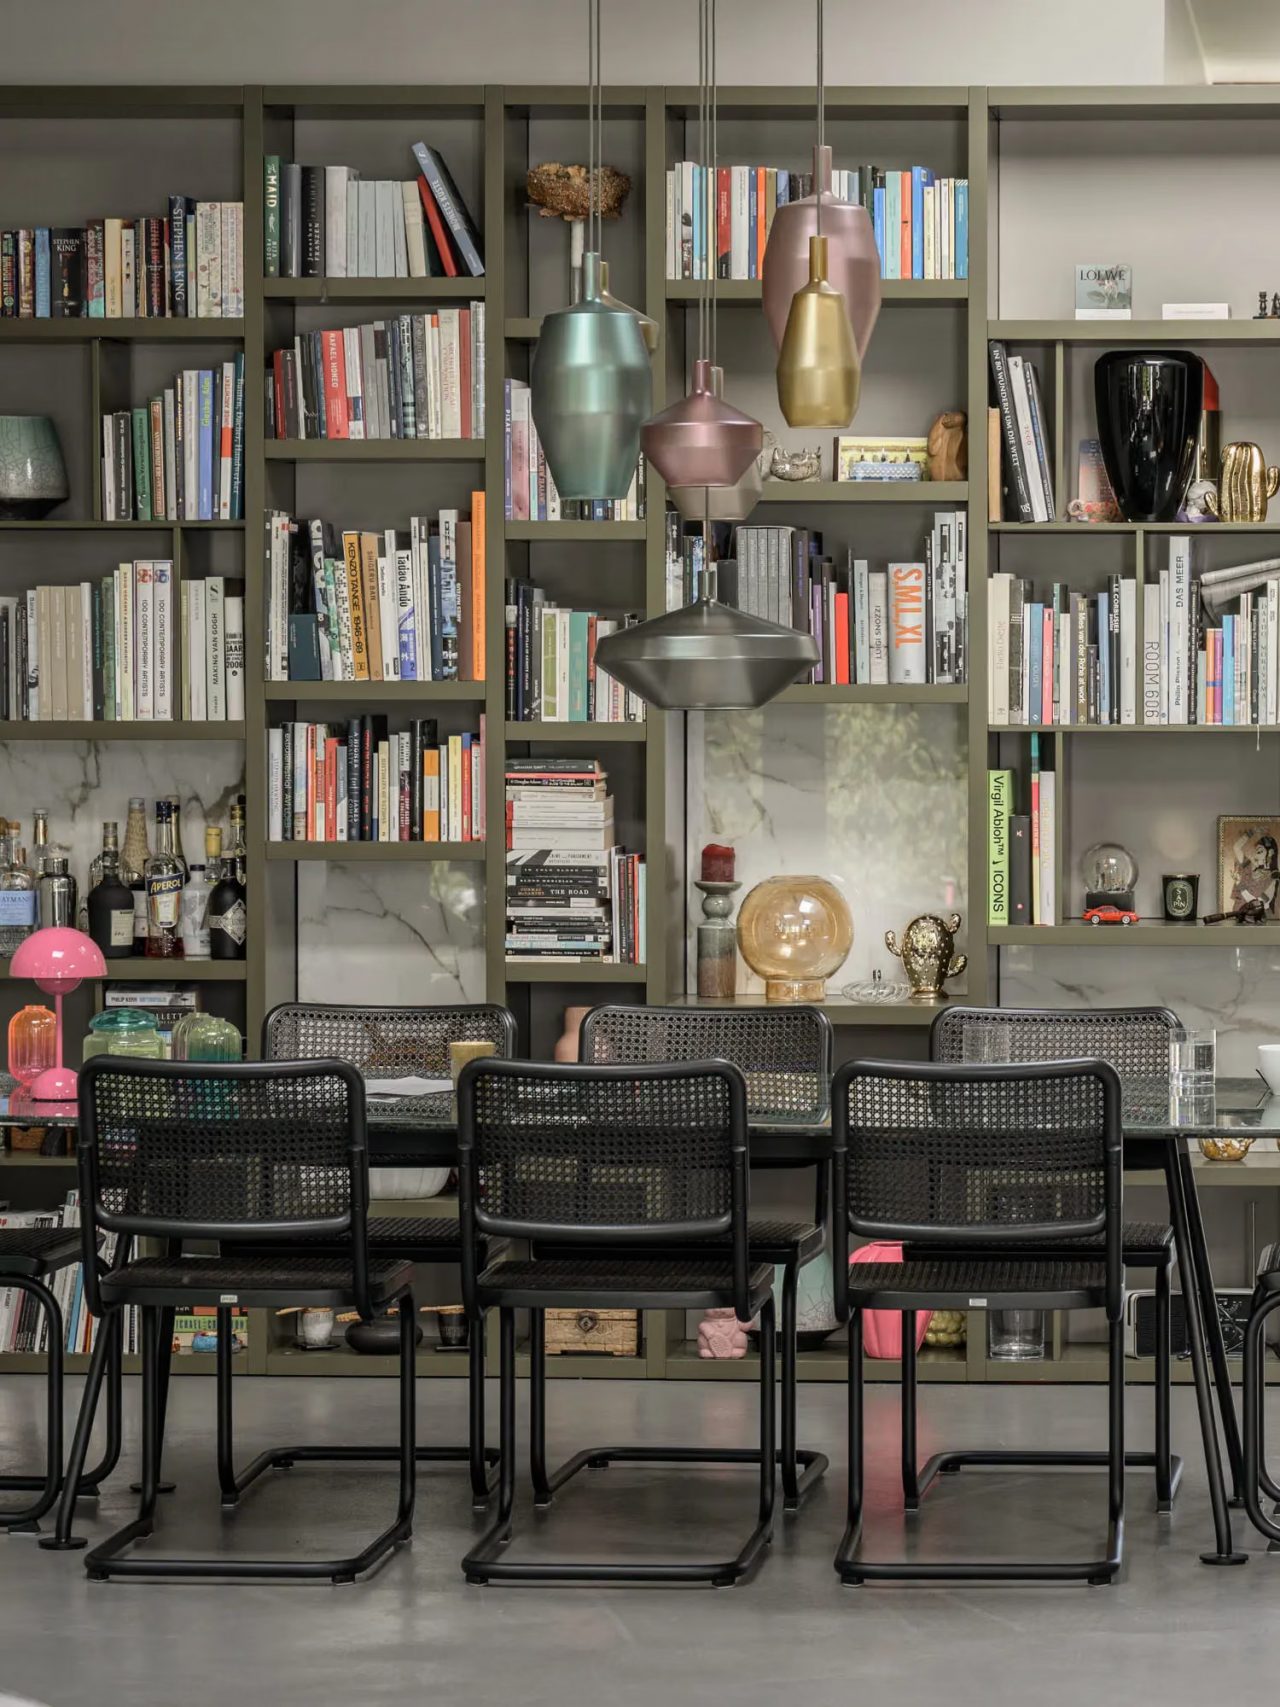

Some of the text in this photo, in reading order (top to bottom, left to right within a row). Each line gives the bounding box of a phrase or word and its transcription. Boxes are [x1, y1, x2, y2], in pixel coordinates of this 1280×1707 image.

[266, 175, 277, 207] MAID
[431, 179, 462, 231] MONETS KÜSTE
[173, 208, 185, 301] STEPHEN KING
[1080, 269, 1126, 281] LOEWE
[329, 333, 337, 361] RAFAEL
[236, 378, 244, 410] Bauten,
[993, 349, 1020, 466] IN 80 WUNDERN UM DIE WELT
[233, 444, 242, 494] Handwerker
[366, 551, 376, 601] SHIGERU BAN
[397, 554, 411, 608] Tadao Ando
[1113, 584, 1120, 592] LE
[1176, 555, 1184, 608] DAS MEER
[28, 597, 36, 619] Banksy
[348, 542, 363, 653] KENZO TANGE 1946-69
[874, 605, 882, 660] LUIGI SNOZZI
[1078, 612, 1086, 629] Mies
[158, 599, 166, 697] 100 CONTEMPORARY ARTISTS
[1078, 644, 1086, 657] der
[1078, 658, 1086, 676] Rohe
[1145, 641, 1159, 718] ROOM 606
[141, 671, 149, 697] ARTISTS
[1078, 686, 1086, 704] work
[284, 732, 292, 789] extraterrestrial
[990, 776, 1004, 806] Virgil
[150, 879, 183, 895] APEROL
[992, 870, 1004, 912] ICONS
[174, 1319, 201, 1329] ICHAEL
